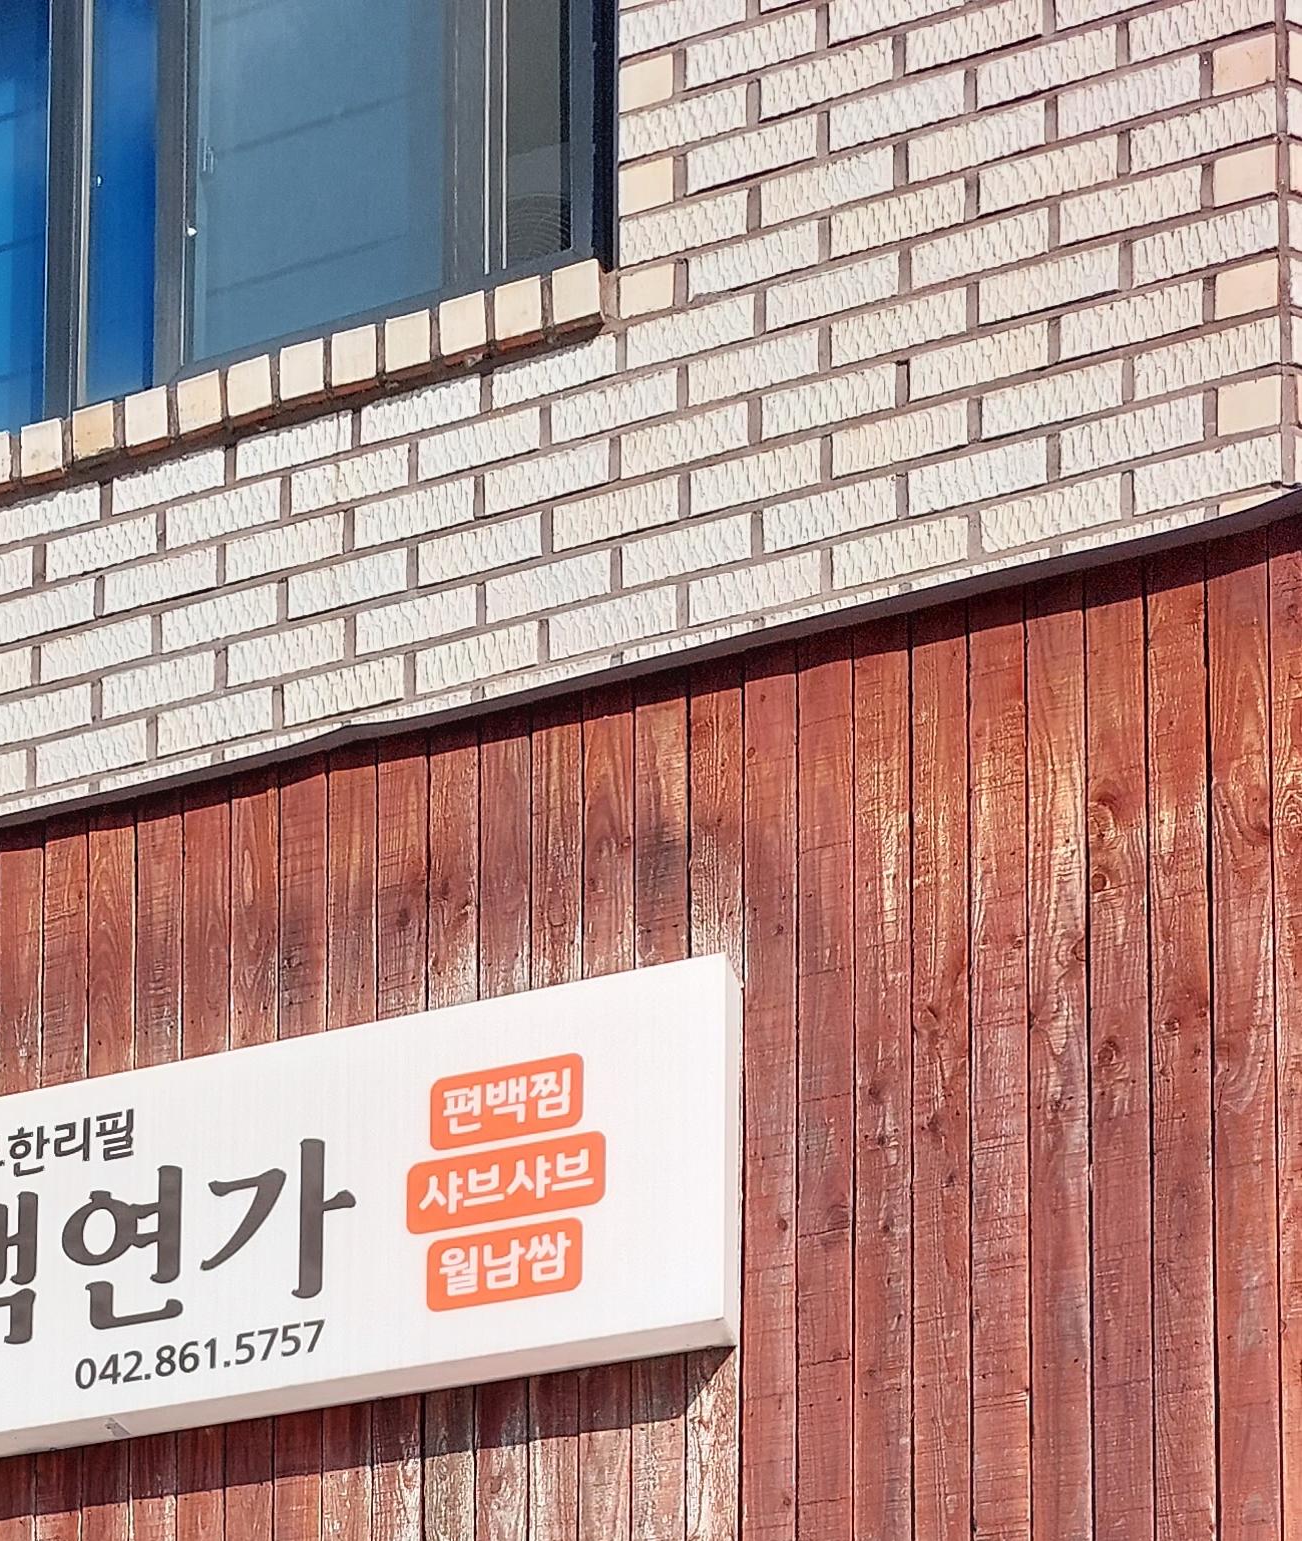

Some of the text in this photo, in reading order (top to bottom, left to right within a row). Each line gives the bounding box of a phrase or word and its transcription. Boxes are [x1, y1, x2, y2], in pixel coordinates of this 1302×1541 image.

[442, 1066, 572, 1135] 편백찜
[417, 1148, 595, 1215] 샤브샤브
[438, 1231, 572, 1297] 월남쌈
[74, 1319, 326, 1390] 042.861.5757
